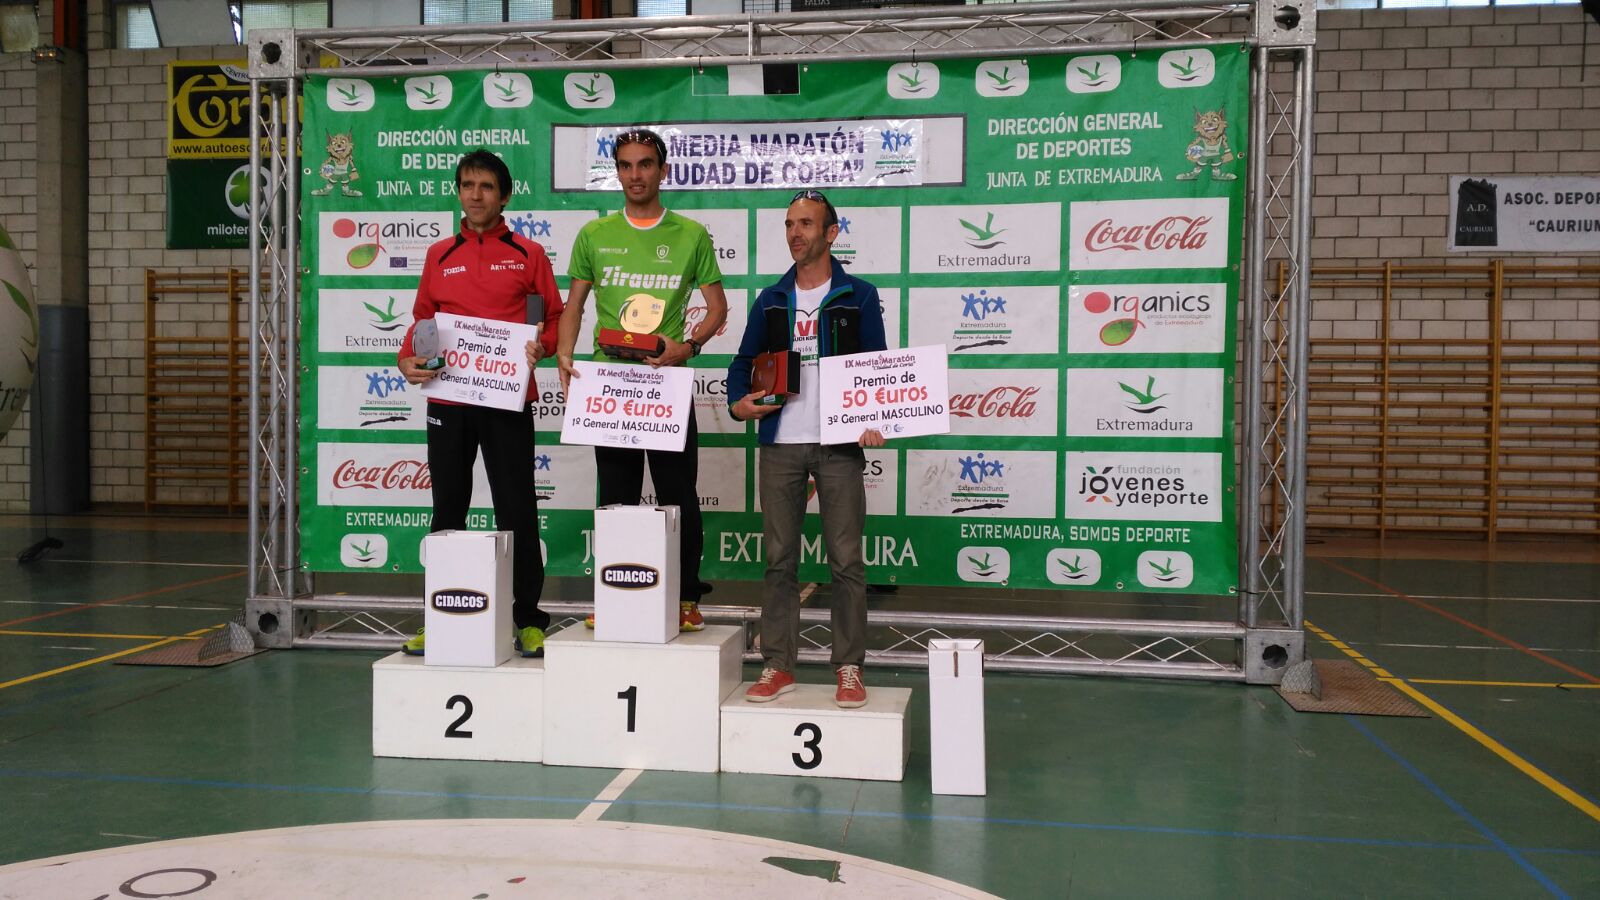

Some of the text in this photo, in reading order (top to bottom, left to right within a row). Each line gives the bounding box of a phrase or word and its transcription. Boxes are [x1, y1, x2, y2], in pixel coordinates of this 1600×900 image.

[988, 112, 1163, 136] DIRECCIÓN GENERAL
[377, 125, 530, 148] DIRECCIÓN GENERAL
[670, 126, 865, 157] MEDIA MARATÓN
[1016, 138, 1132, 160] DE DEPORTES
[402, 153, 422, 170] DE
[666, 162, 737, 185] IUDAD
[745, 162, 774, 185] DE
[986, 167, 1163, 191] JUNTA DE EXTREMADURA
[376, 180, 412, 198] JUNTA
[420, 180, 435, 196] DE
[1466, 203, 1489, 212] A.D.
[1504, 192, 1549, 205] ASOC.
[1084, 216, 1213, 252] Coca-Cola
[938, 254, 1031, 268] Extremadura
[454, 320, 511, 336] IX Media Maratón
[345, 335, 406, 348] Extremad
[457, 338, 507, 357] Premio de
[845, 354, 916, 369] IX Media Maratón
[440, 371, 471, 385] General
[472, 376, 521, 393] MASCULINO
[598, 368, 664, 380] IX Media Maratón
[854, 371, 916, 388] Premio de
[602, 385, 661, 400] Premio de
[842, 389, 868, 409] 50
[586, 396, 617, 414] 150
[949, 386, 1041, 418] ca-Cola
[841, 411, 878, 424] General
[881, 404, 944, 420] MASCULINO
[583, 418, 619, 430] General
[621, 420, 680, 434] MASCULINO
[1096, 418, 1193, 432] Extremadura
[1117, 464, 1181, 475] fundación
[1116, 492, 1208, 507] ydeporte
[961, 523, 1190, 543] EXTREMADURA, SOMOS DEPORTE
[444, 694, 474, 739] 2
[617, 685, 637, 733] 1
[791, 722, 823, 770] 3
